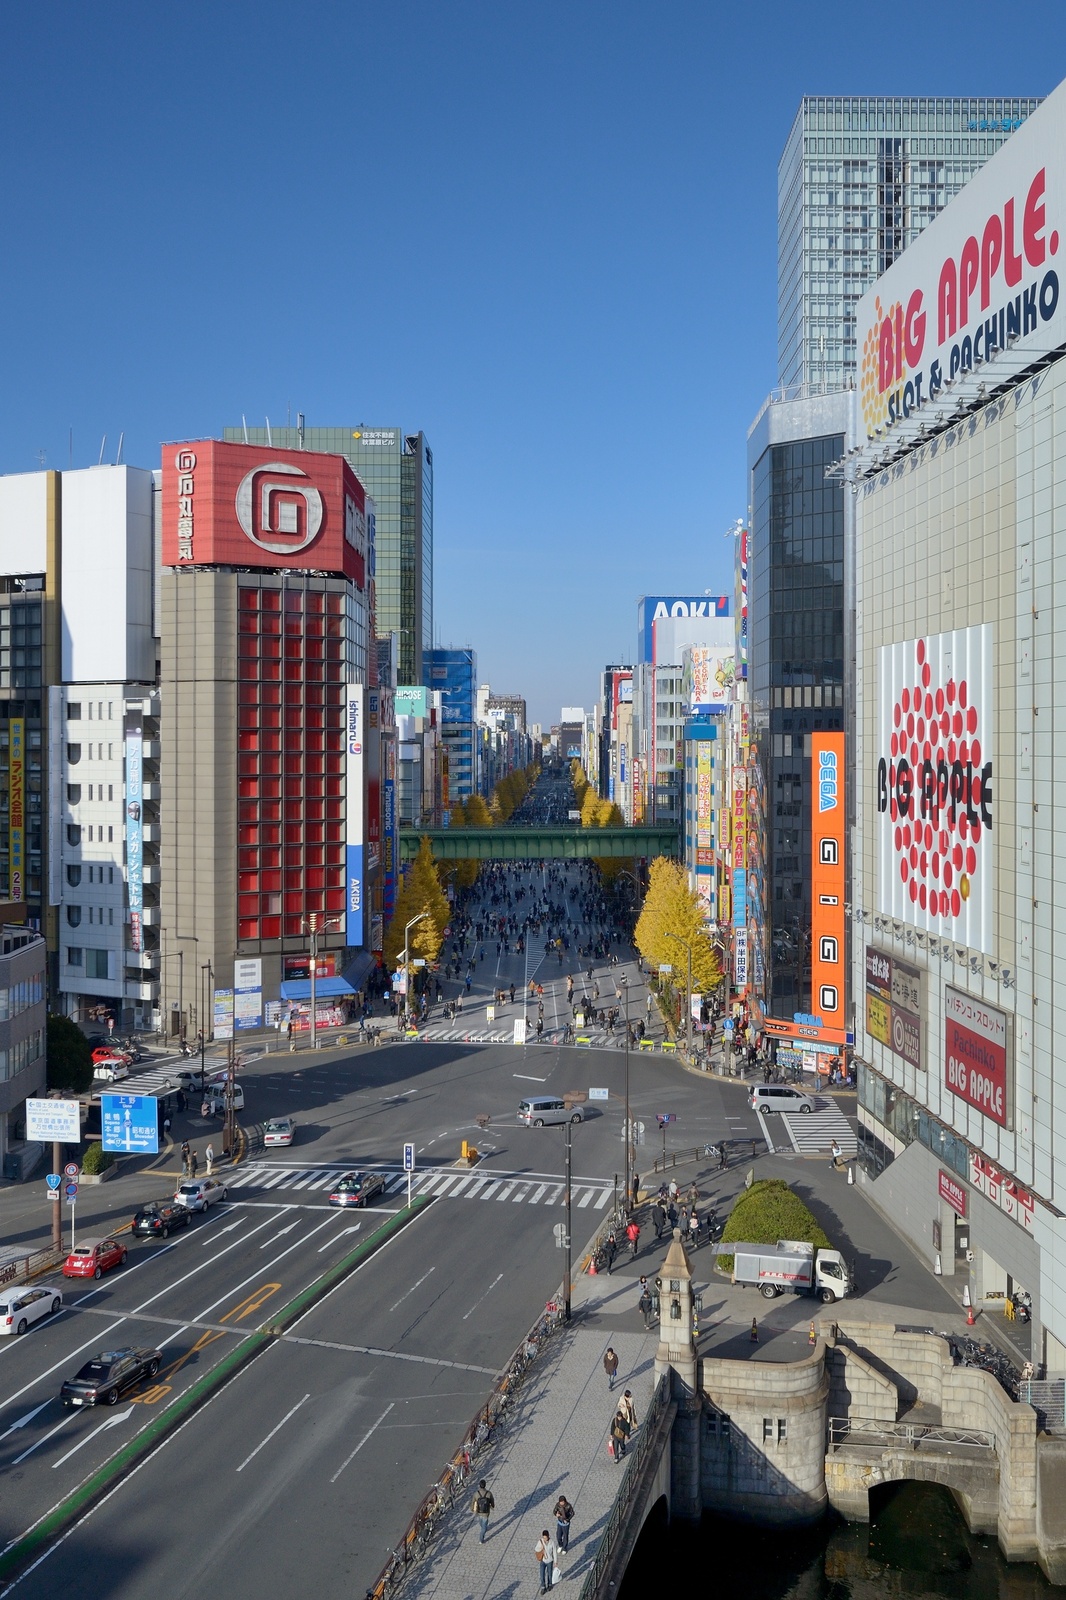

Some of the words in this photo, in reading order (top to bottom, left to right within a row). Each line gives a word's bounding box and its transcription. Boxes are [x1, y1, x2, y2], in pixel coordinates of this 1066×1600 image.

[878, 288, 927, 395] BIG
[887, 371, 923, 424] SLOT
[949, 269, 1060, 381] PACHINKO
[362, 431, 395, 439] 住友不動産
[177, 473, 194, 560] 石丸電気
[349, 700, 359, 742] ishimaru
[396, 690, 422, 700] HIROSE
[385, 785, 393, 831] Panasonic
[820, 750, 838, 814] SEGA
[877, 757, 911, 818] BIG
[921, 758, 993, 831] APPLE
[385, 836, 393, 873] ONODEN
[350, 878, 361, 912] AKIBA
[953, 1029, 996, 1072] Pachinko
[948, 1055, 967, 1092] BIG
[969, 1069, 1003, 1117] APPLE
[973, 1168, 1031, 1227] スロット
